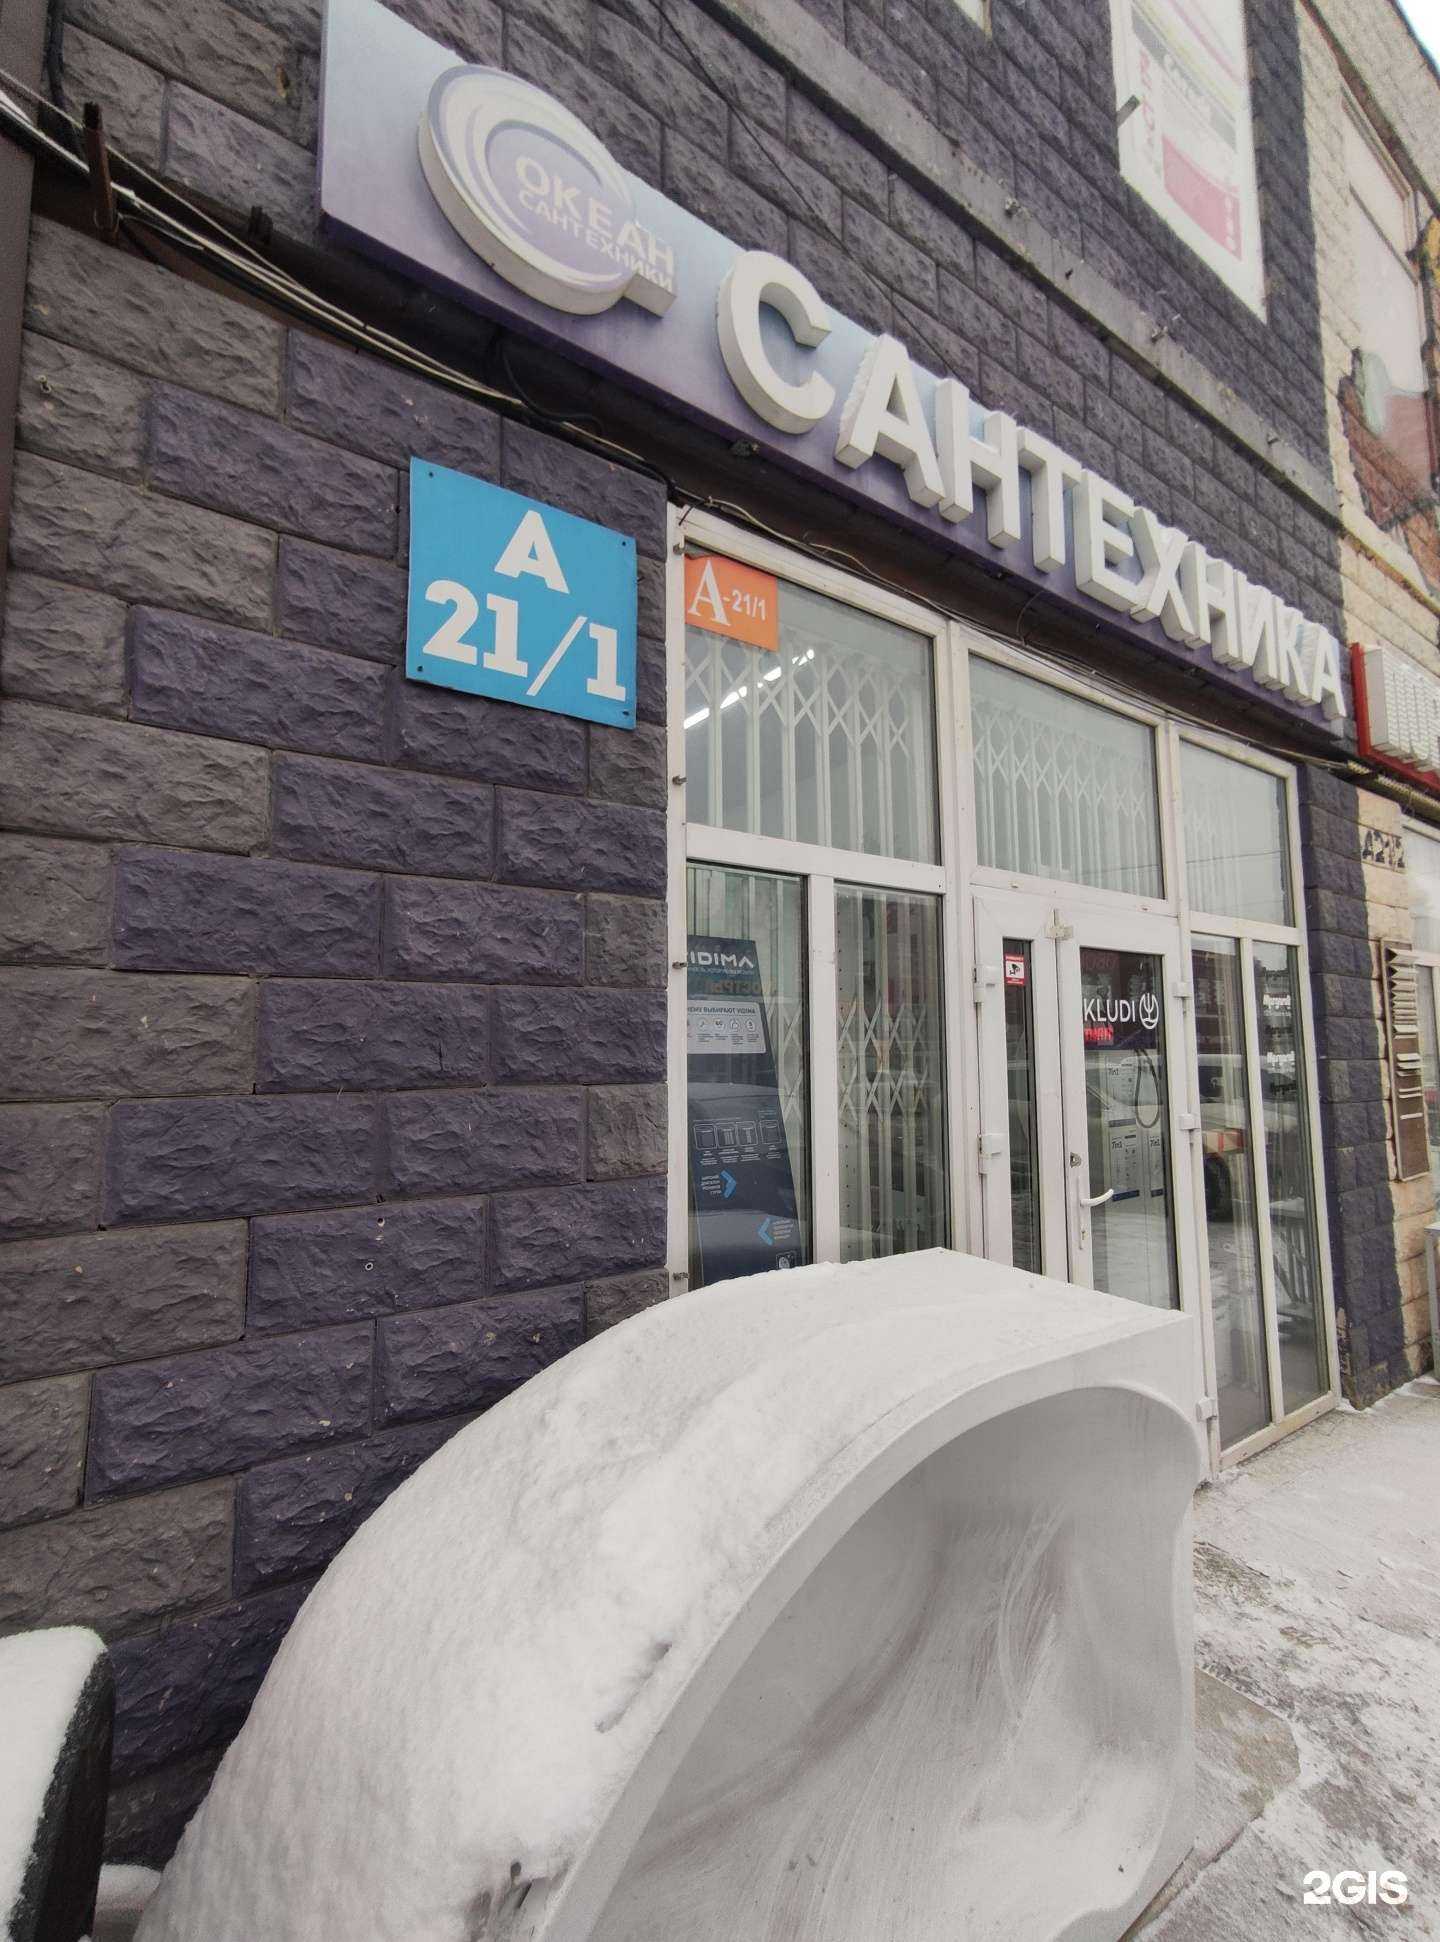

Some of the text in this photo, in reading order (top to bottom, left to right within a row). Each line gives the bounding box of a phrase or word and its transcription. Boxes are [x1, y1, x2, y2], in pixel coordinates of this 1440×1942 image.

[516, 157, 674, 277] ОКЕАН
[519, 189, 673, 293] САНТЕХНИКИ
[717, 250, 1346, 720] САНТЕХНИКА
[494, 510, 570, 594] А
[423, 579, 626, 701] 21/1
[687, 951, 754, 969] IDIMA
[1083, 998, 1136, 1023] KLUDI
